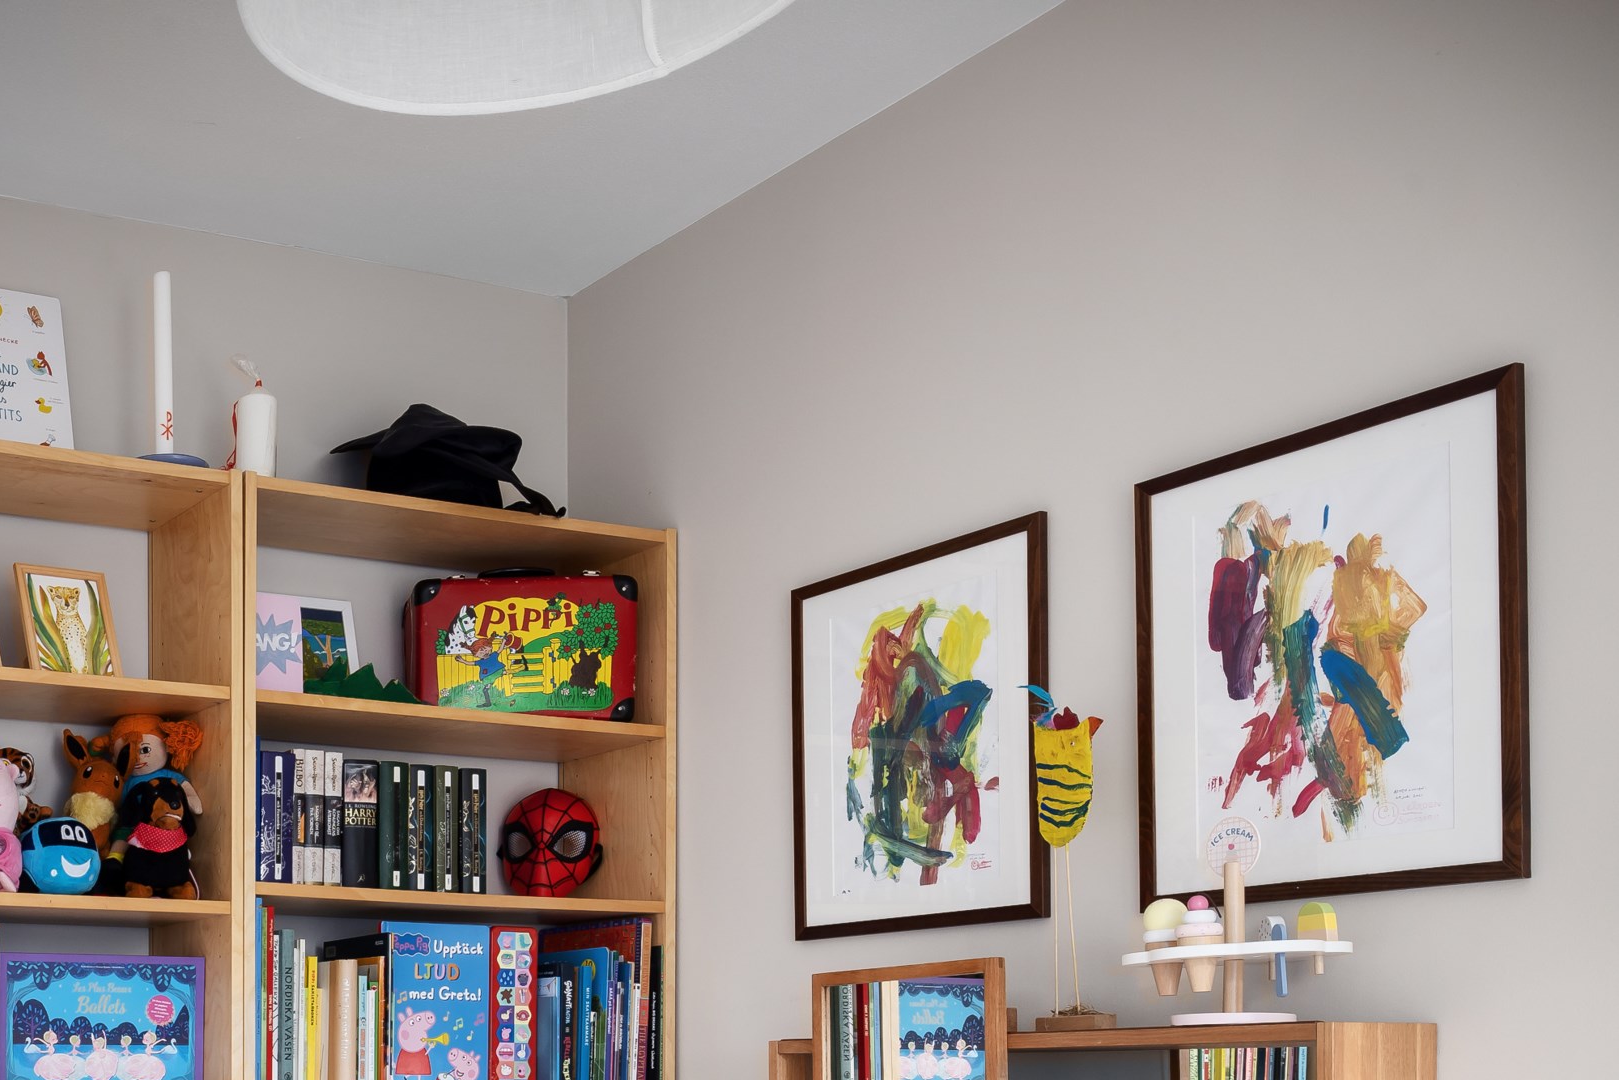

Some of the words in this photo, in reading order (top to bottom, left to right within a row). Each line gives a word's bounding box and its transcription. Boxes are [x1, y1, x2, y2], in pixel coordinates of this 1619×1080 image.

[256, 633, 297, 653] ANG!
[296, 759, 304, 787] BILBO
[345, 808, 376, 817] HARRY
[345, 817, 376, 825] POTTER
[1211, 833, 1223, 846] ICE
[1226, 828, 1254, 842] CREAM
[394, 936, 415, 952] Peppa
[417, 937, 428, 953] Pig
[434, 940, 483, 958] Upptäck
[414, 963, 460, 980] LJUD
[88, 982, 105, 992] Plus
[283, 966, 292, 1022] NORDISKA
[409, 988, 434, 1000] med
[439, 986, 481, 1001] Greta!
[75, 994, 126, 1015] Ballets
[284, 1026, 293, 1060] VÄSEN
[638, 1025, 646, 1043] THE
